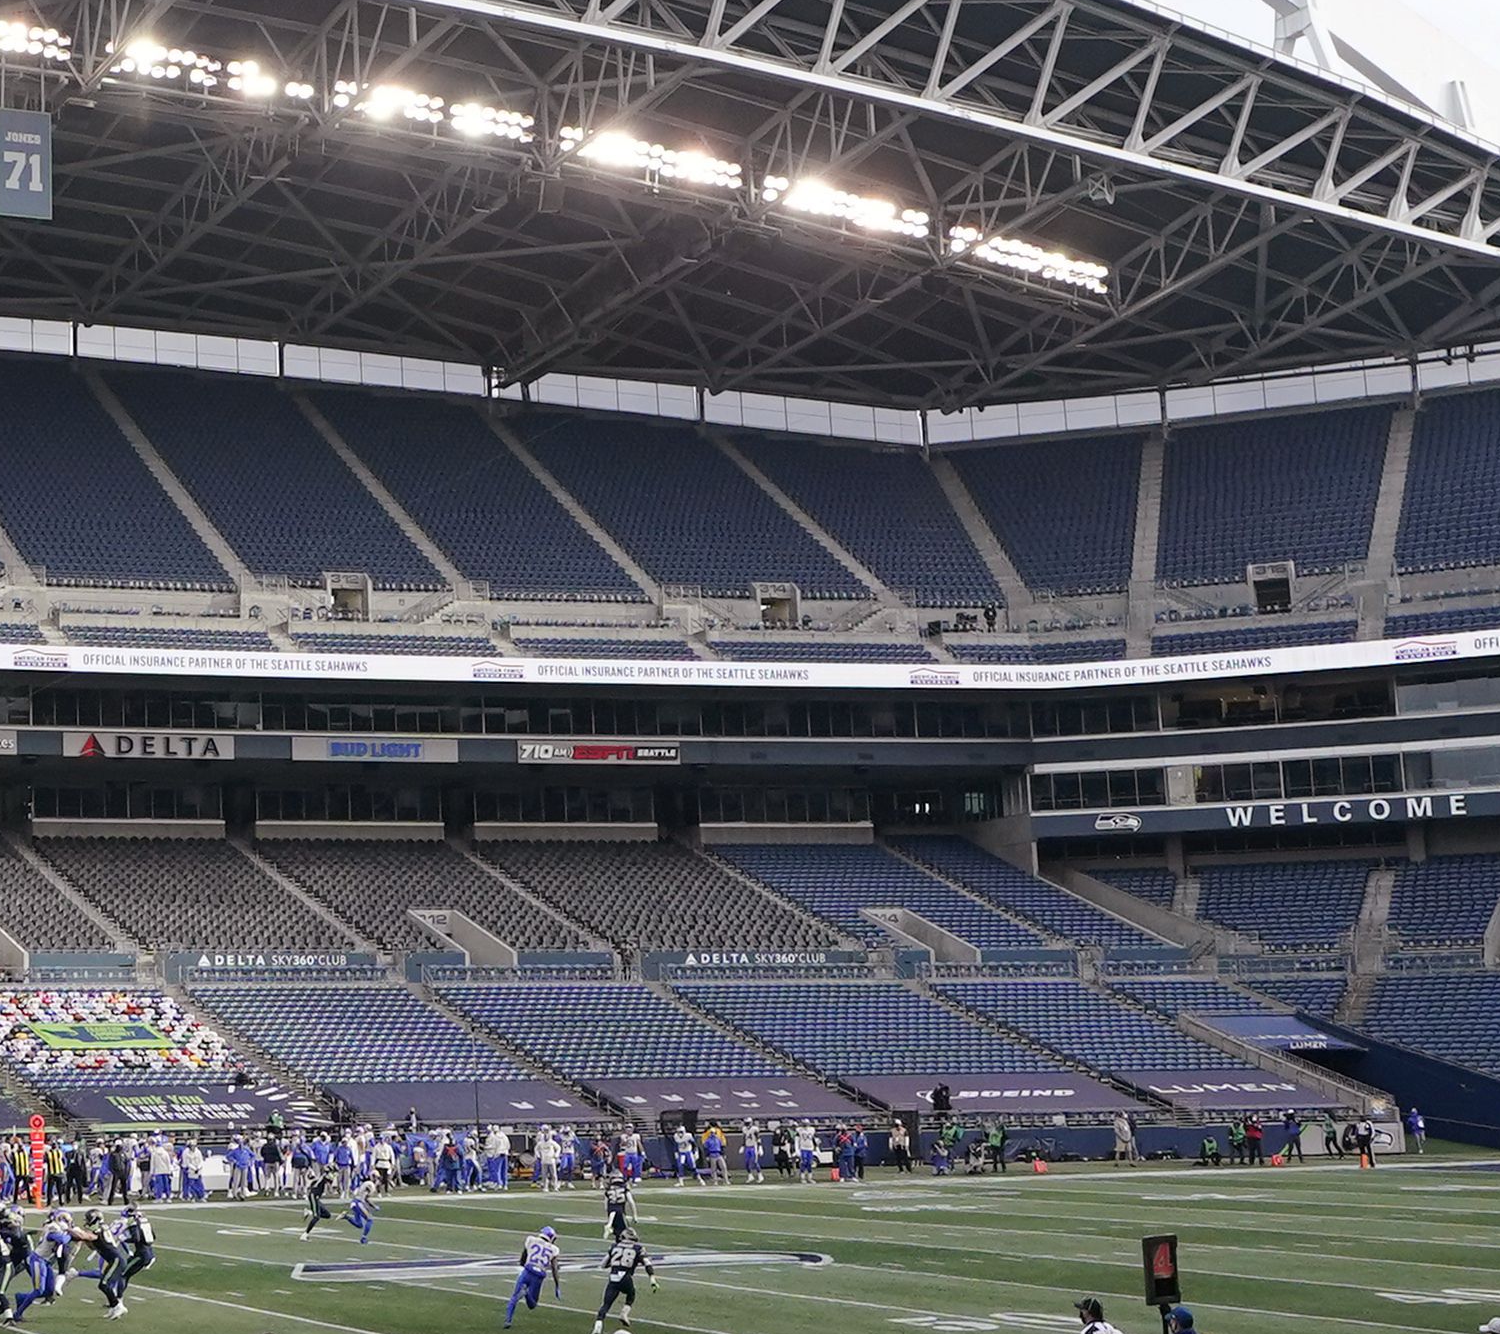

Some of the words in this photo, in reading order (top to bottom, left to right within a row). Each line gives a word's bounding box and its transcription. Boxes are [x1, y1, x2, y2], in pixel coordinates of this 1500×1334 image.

[4, 130, 42, 145] JONES
[3, 151, 43, 192] 71
[116, 735, 219, 757] DELTA
[329, 741, 369, 758] BUD
[372, 741, 423, 759] LIGHT
[519, 744, 553, 759] 710
[573, 744, 634, 760] ESPN
[636, 747, 677, 758] SEATTLE
[1225, 793, 1467, 828] WELCOME
[1289, 1040, 1327, 1049] LUMEN
[958, 1088, 1076, 1099] BOEING
[1150, 1083, 1297, 1093] LUMEN
[105, 1094, 165, 1106] Thank
[168, 1094, 203, 1106] You
[528, 1243, 552, 1263] 25
[609, 1246, 637, 1266] 28
[1152, 1242, 1173, 1277] 4
